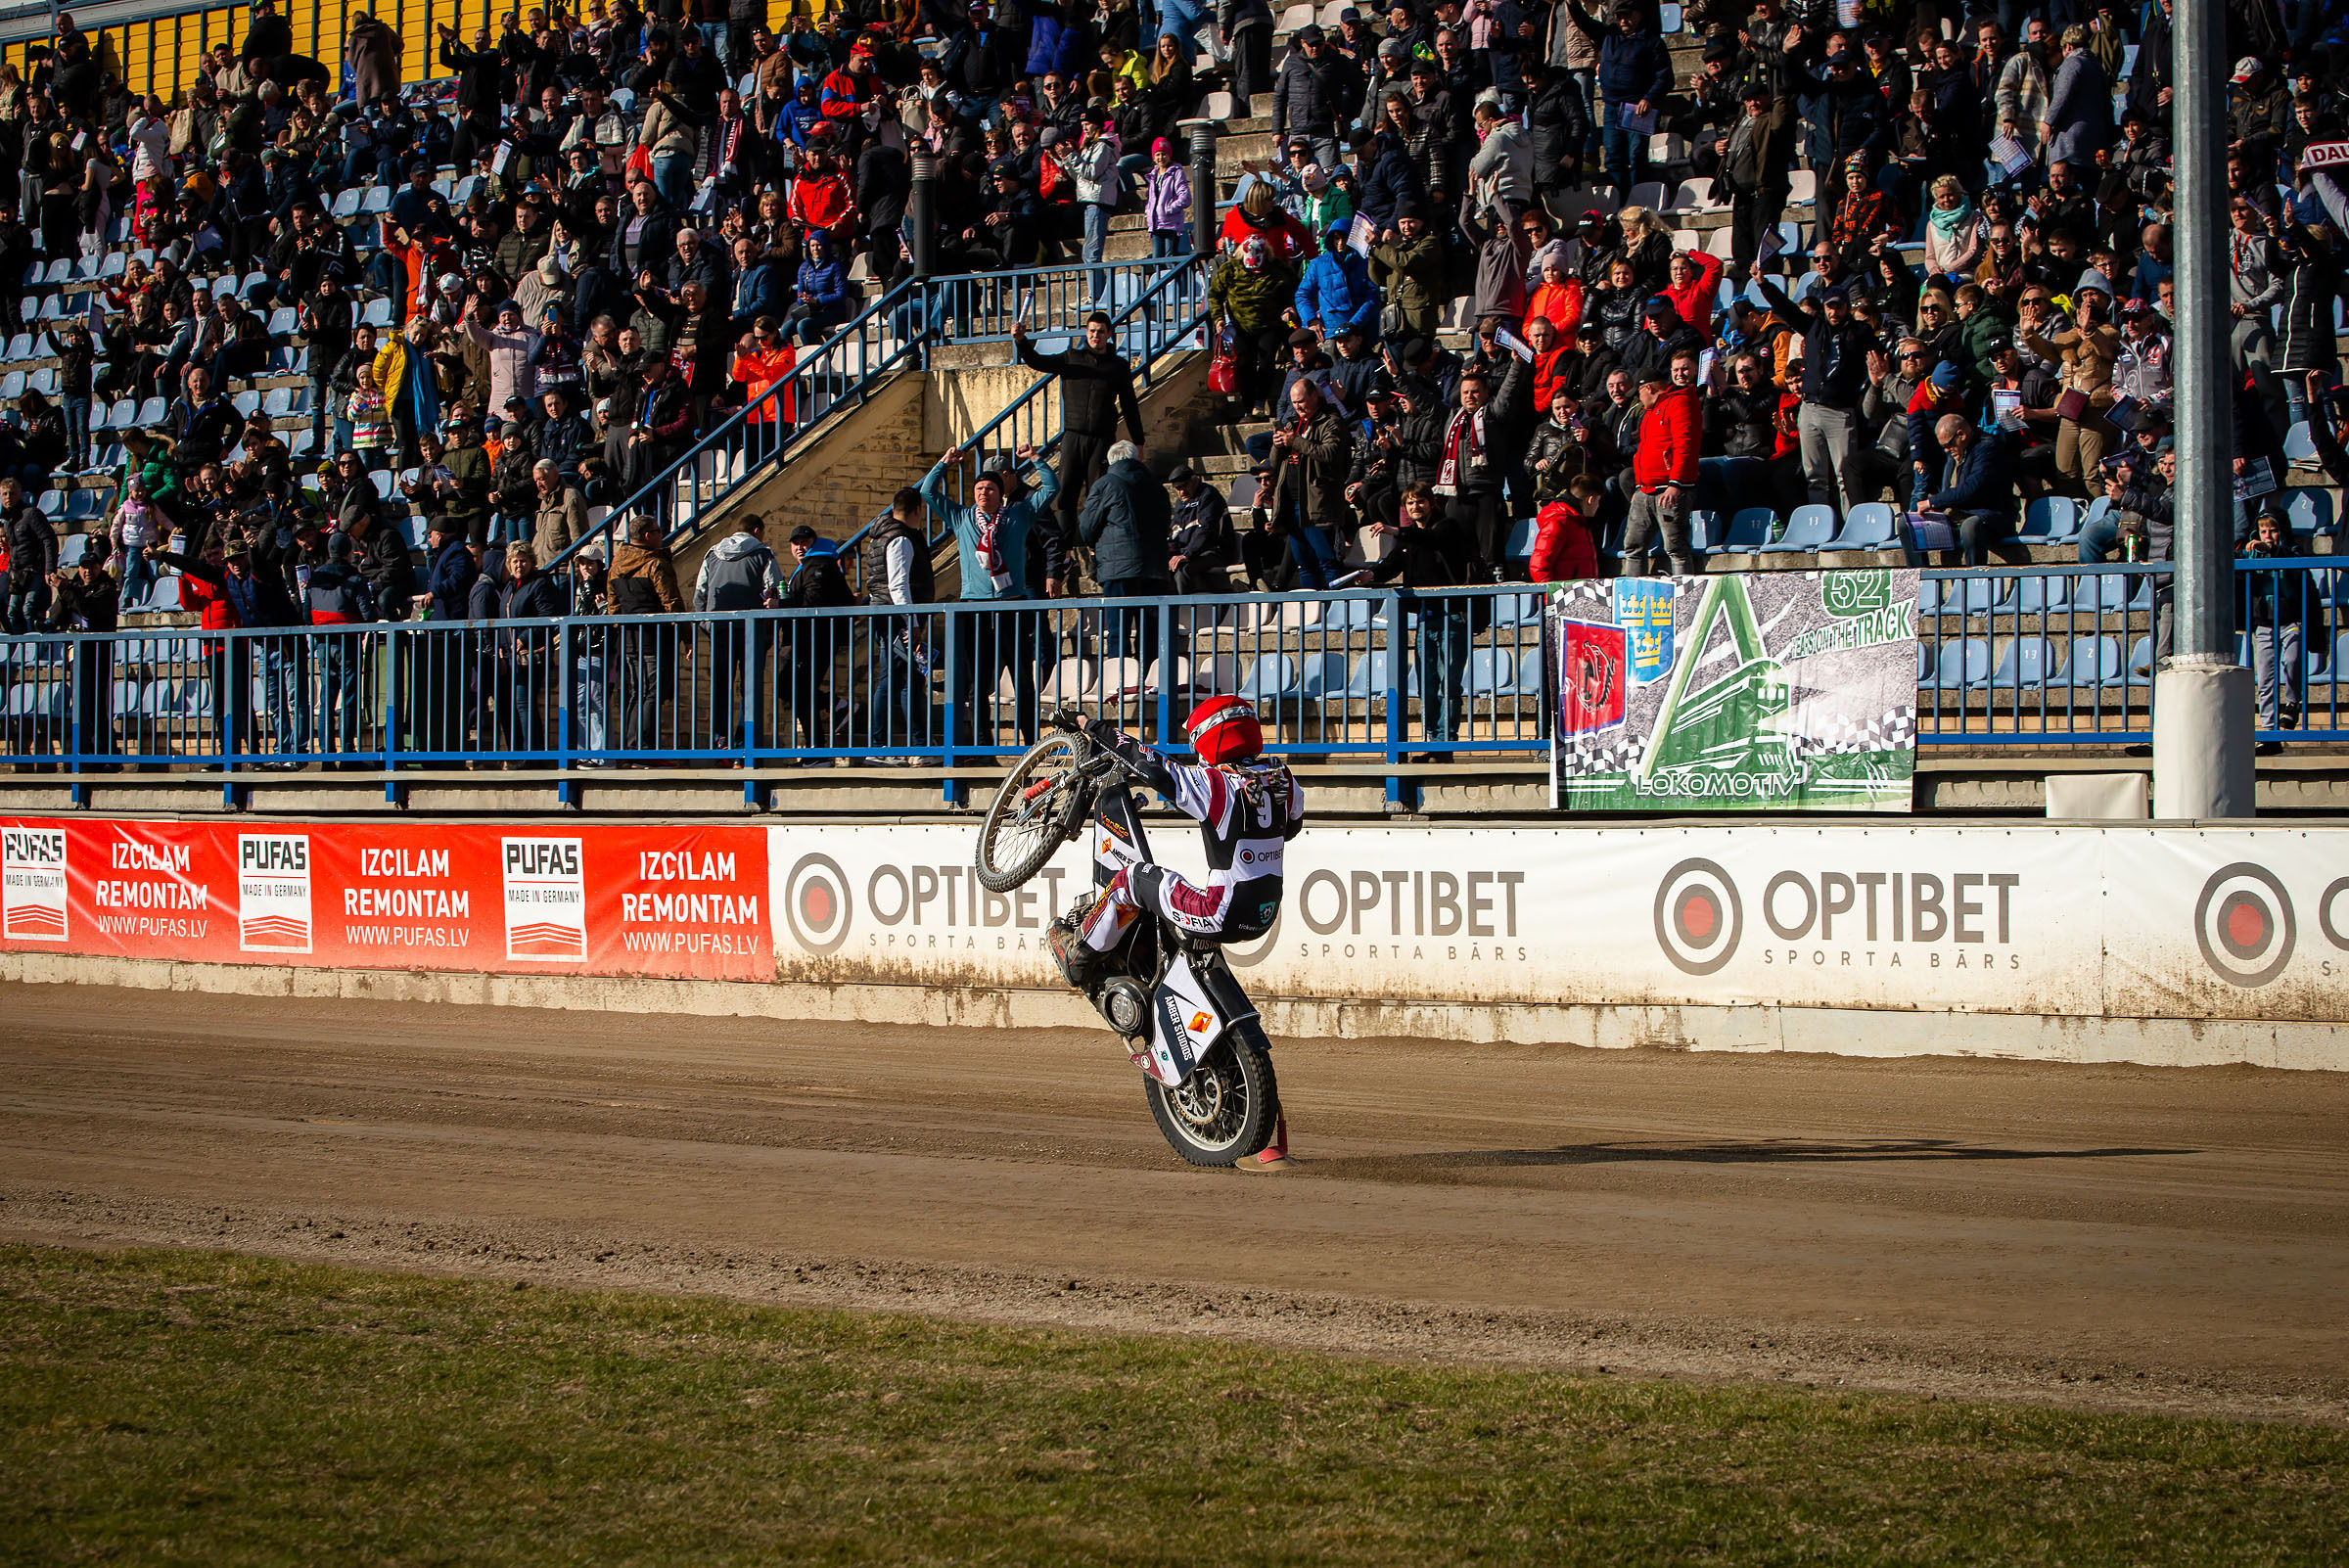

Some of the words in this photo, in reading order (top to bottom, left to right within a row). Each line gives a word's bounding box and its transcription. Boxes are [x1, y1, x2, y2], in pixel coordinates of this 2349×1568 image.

[1808, 517, 1820, 526] 13
[1830, 569, 1883, 609] 52
[1816, 627, 1830, 653] ON
[1831, 620, 1854, 650] THE
[1856, 599, 1915, 647] TRACK
[1635, 771, 1799, 797] LOKOMOTIV
[6, 834, 63, 862] PUFAS
[112, 843, 191, 872] IZCILAM
[243, 841, 305, 870] PUFAS
[507, 844, 577, 874] PUFAS
[360, 849, 449, 878] IZCILAM
[639, 852, 735, 881] IZCILAM
[96, 880, 207, 910] REMONTAM
[243, 884, 260, 897] MADE
[263, 885, 271, 897] IN
[274, 885, 306, 898] GERMANY
[345, 889, 469, 918] REMONTAM
[508, 890, 530, 902] MADE
[533, 891, 540, 902] IN
[543, 891, 579, 903] GERMANY
[867, 863, 1066, 928] OPTIBET
[1299, 868, 1525, 937] OPTIBET
[622, 894, 759, 924] REMONTAM
[1763, 870, 2020, 944] OPTIBET
[99, 915, 207, 939] WWW.PUFAS.LV
[345, 926, 470, 947] WWW.PUFAS.LV
[622, 931, 759, 955] WWW.PUFAS.LV
[869, 933, 975, 949] SPORTA
[996, 933, 1046, 951] BĀR
[1301, 943, 1423, 959] SPORTA
[1448, 942, 1527, 961] BĀRS
[1764, 948, 1902, 968] SPORTA
[1930, 947, 2020, 970] BĀRS
[1165, 994, 1180, 1025] AMBER
[1174, 1022, 1193, 1061] STUDIOS
